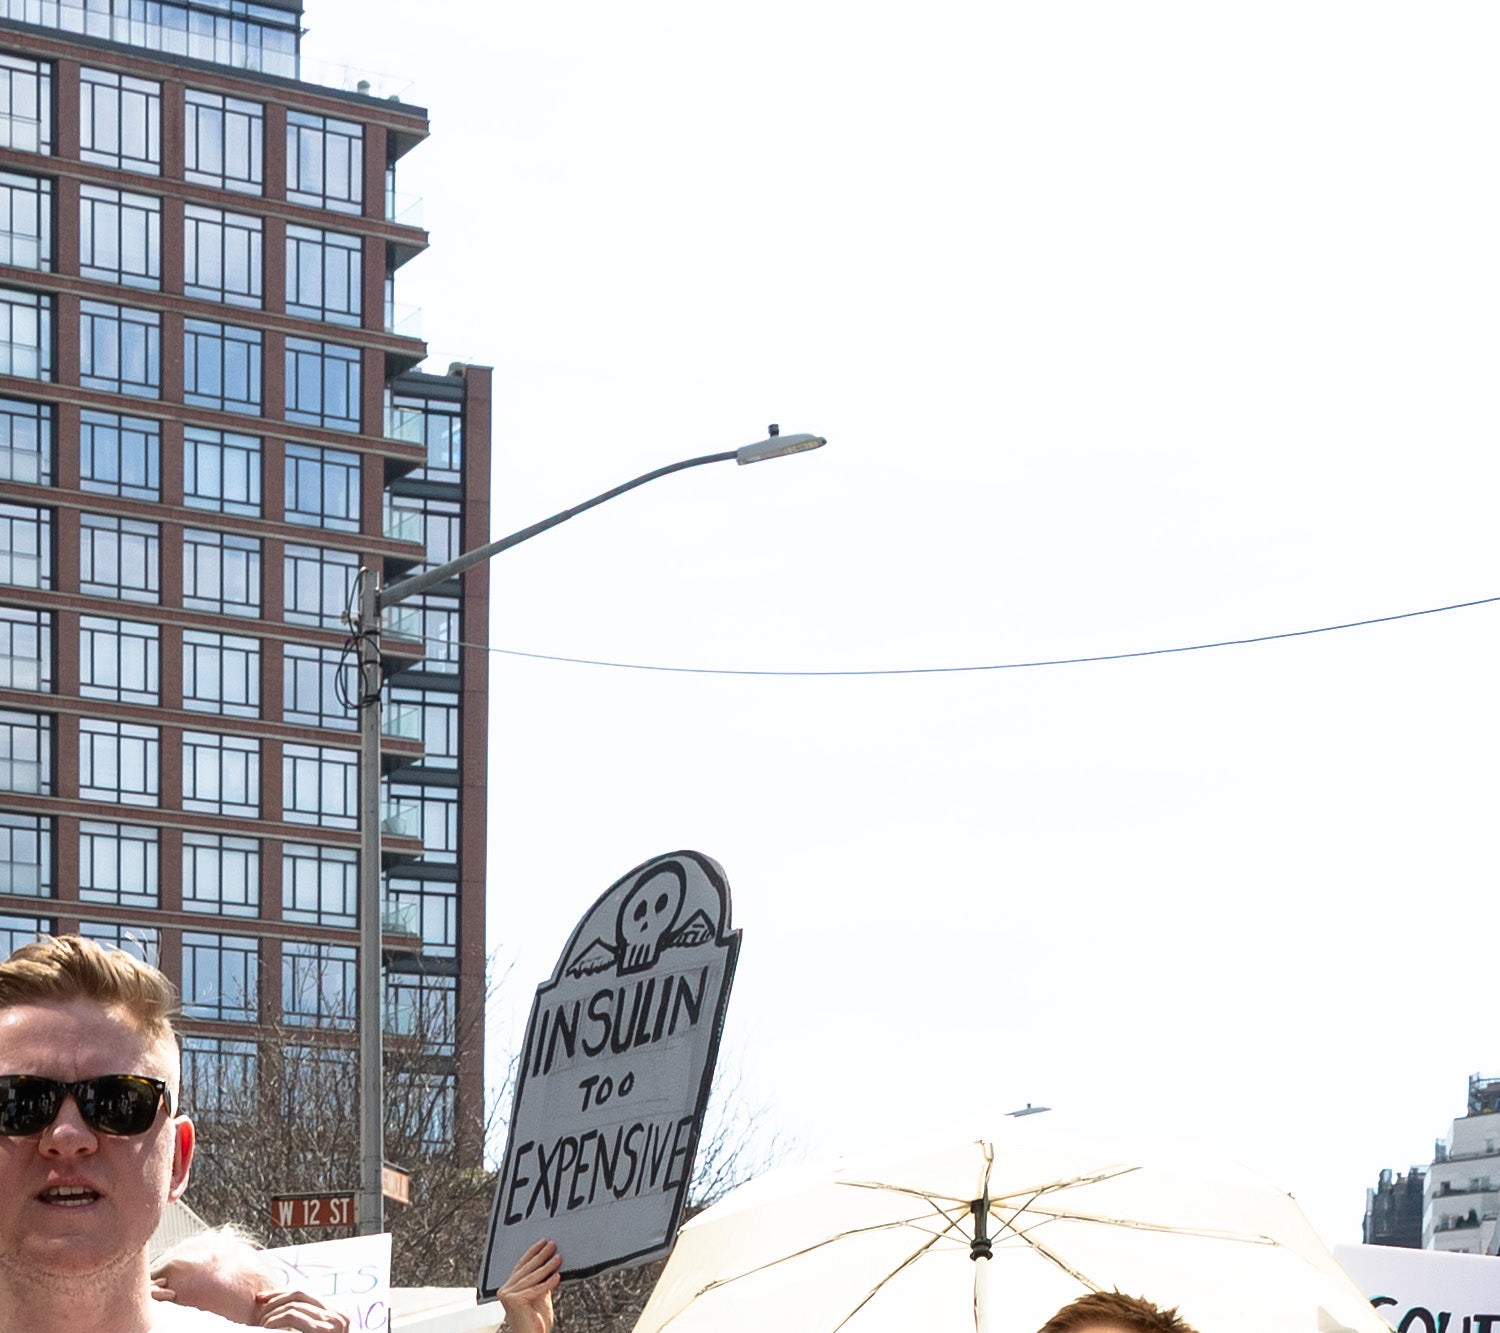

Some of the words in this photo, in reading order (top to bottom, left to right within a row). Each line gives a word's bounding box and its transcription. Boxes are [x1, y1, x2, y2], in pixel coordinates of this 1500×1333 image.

[532, 966, 709, 1077] INSULIN
[579, 1071, 635, 1112] TOO
[503, 1114, 696, 1225] EXPENSIVE
[278, 1200, 294, 1227] W
[303, 1199, 321, 1226] 12
[329, 1198, 350, 1225] ST
